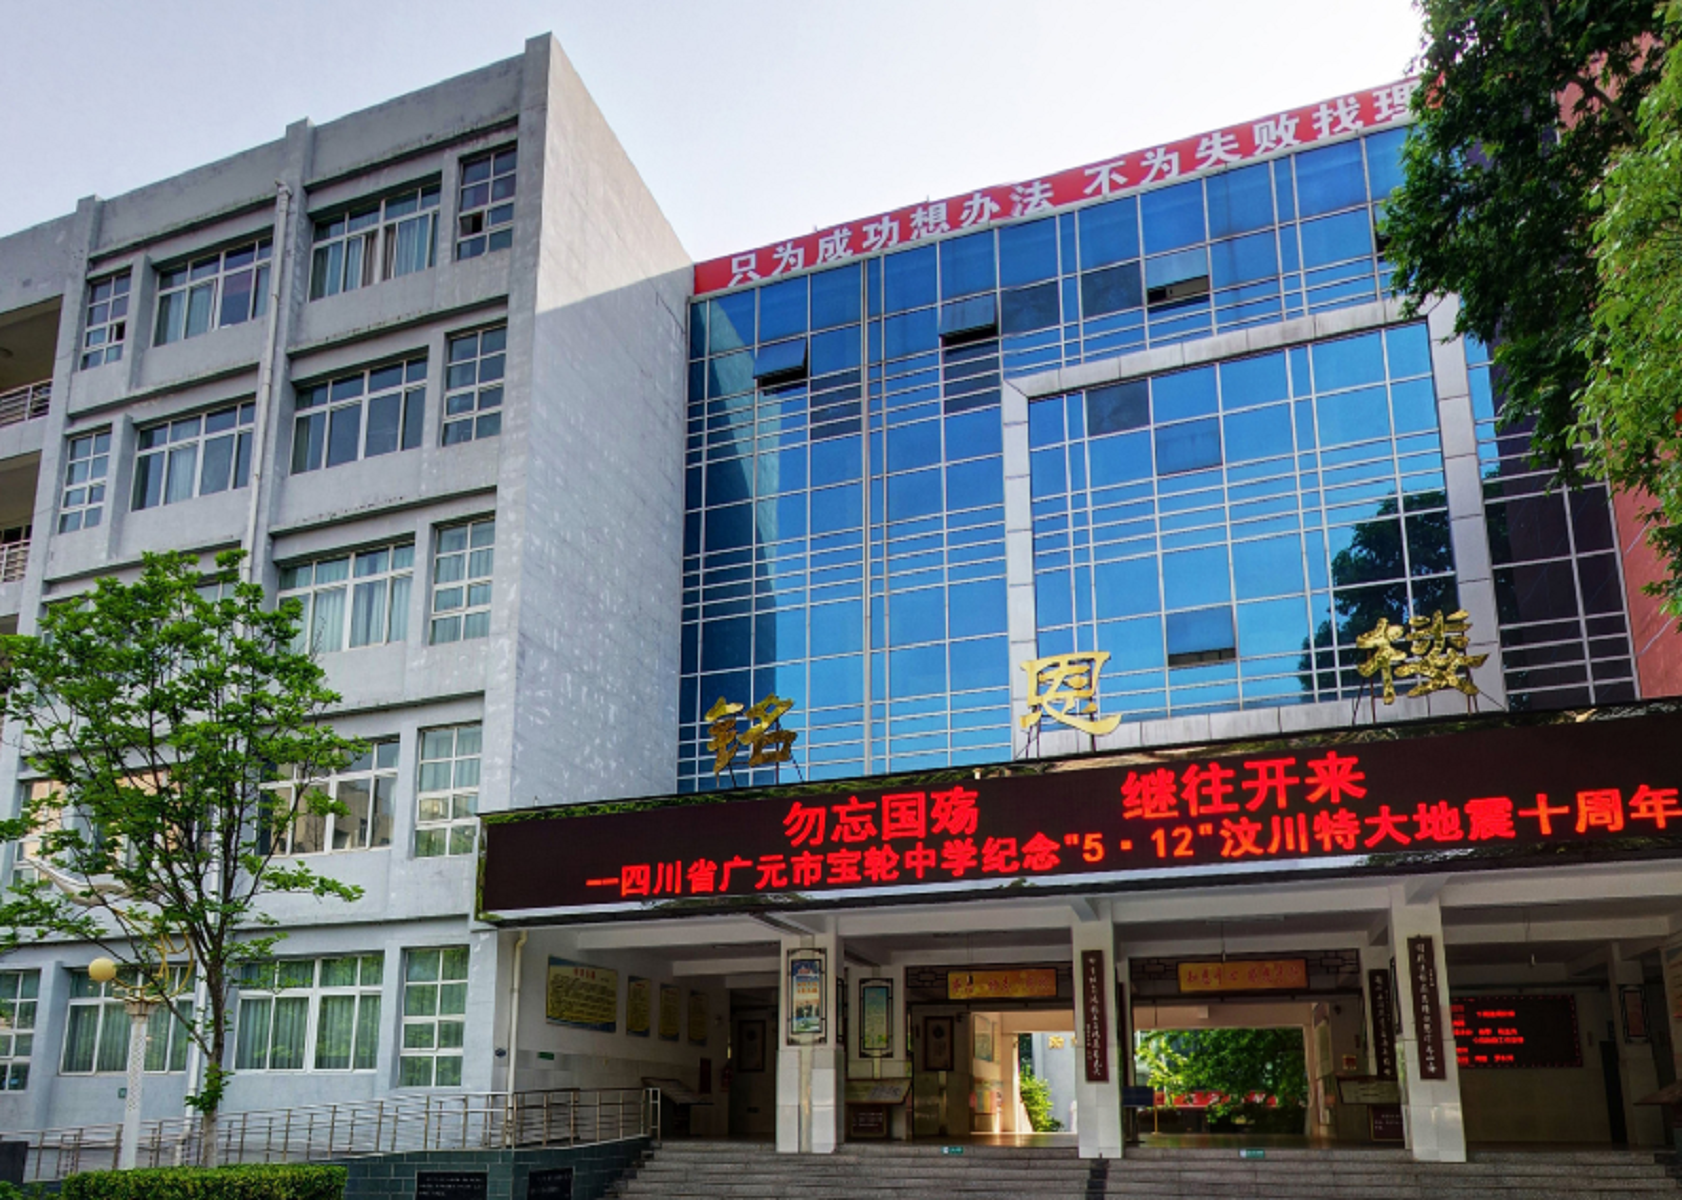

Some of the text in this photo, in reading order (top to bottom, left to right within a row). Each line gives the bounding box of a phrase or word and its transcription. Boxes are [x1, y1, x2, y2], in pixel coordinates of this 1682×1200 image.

[727, 181, 1056, 288] 只为成功想办法
[783, 751, 1367, 847] 勿忘国殇 继往开来
